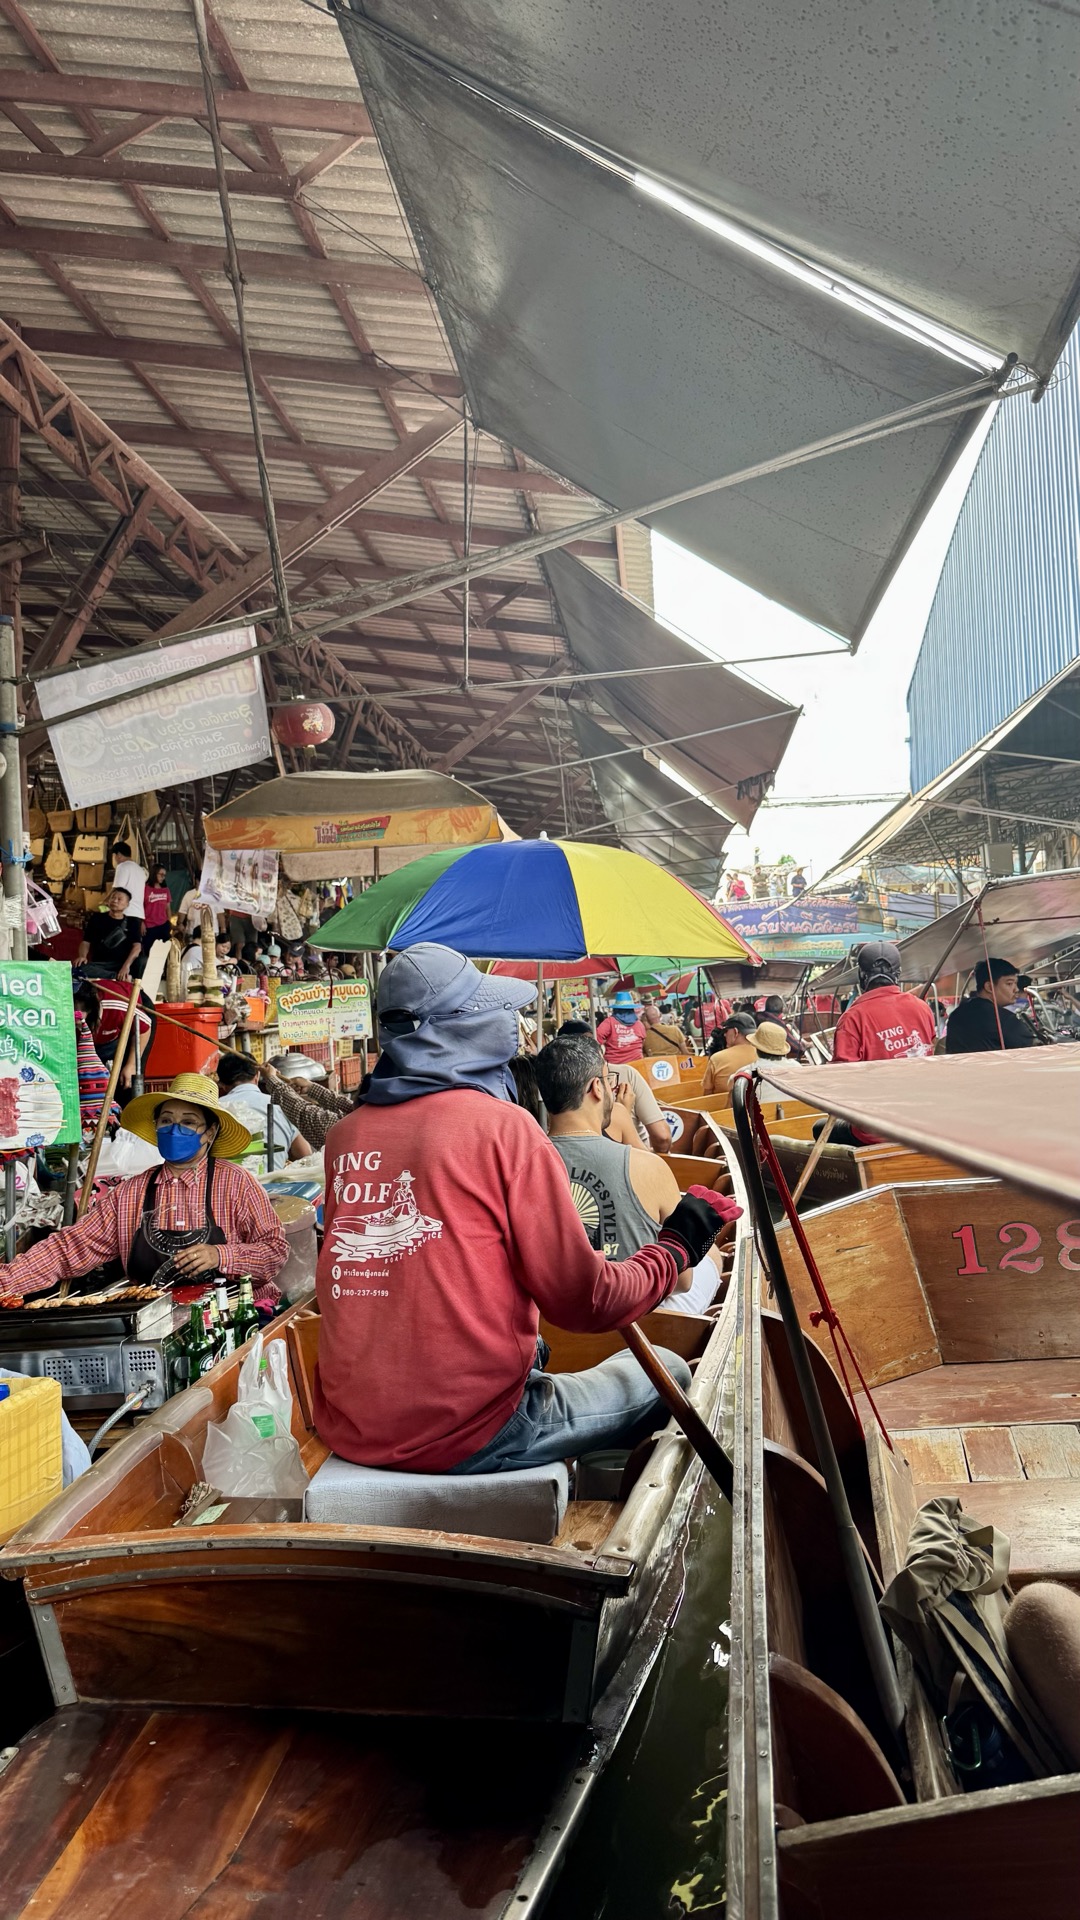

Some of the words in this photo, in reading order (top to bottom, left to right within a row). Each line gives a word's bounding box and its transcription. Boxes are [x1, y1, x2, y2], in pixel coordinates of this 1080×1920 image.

[876, 1025, 904, 1041] YING
[885, 1036, 914, 1051] GOLF
[570, 1166, 616, 1243] LIFESTYLE
[408, 1231, 443, 1256] SERVICE
[603, 1243, 619, 1256] 87
